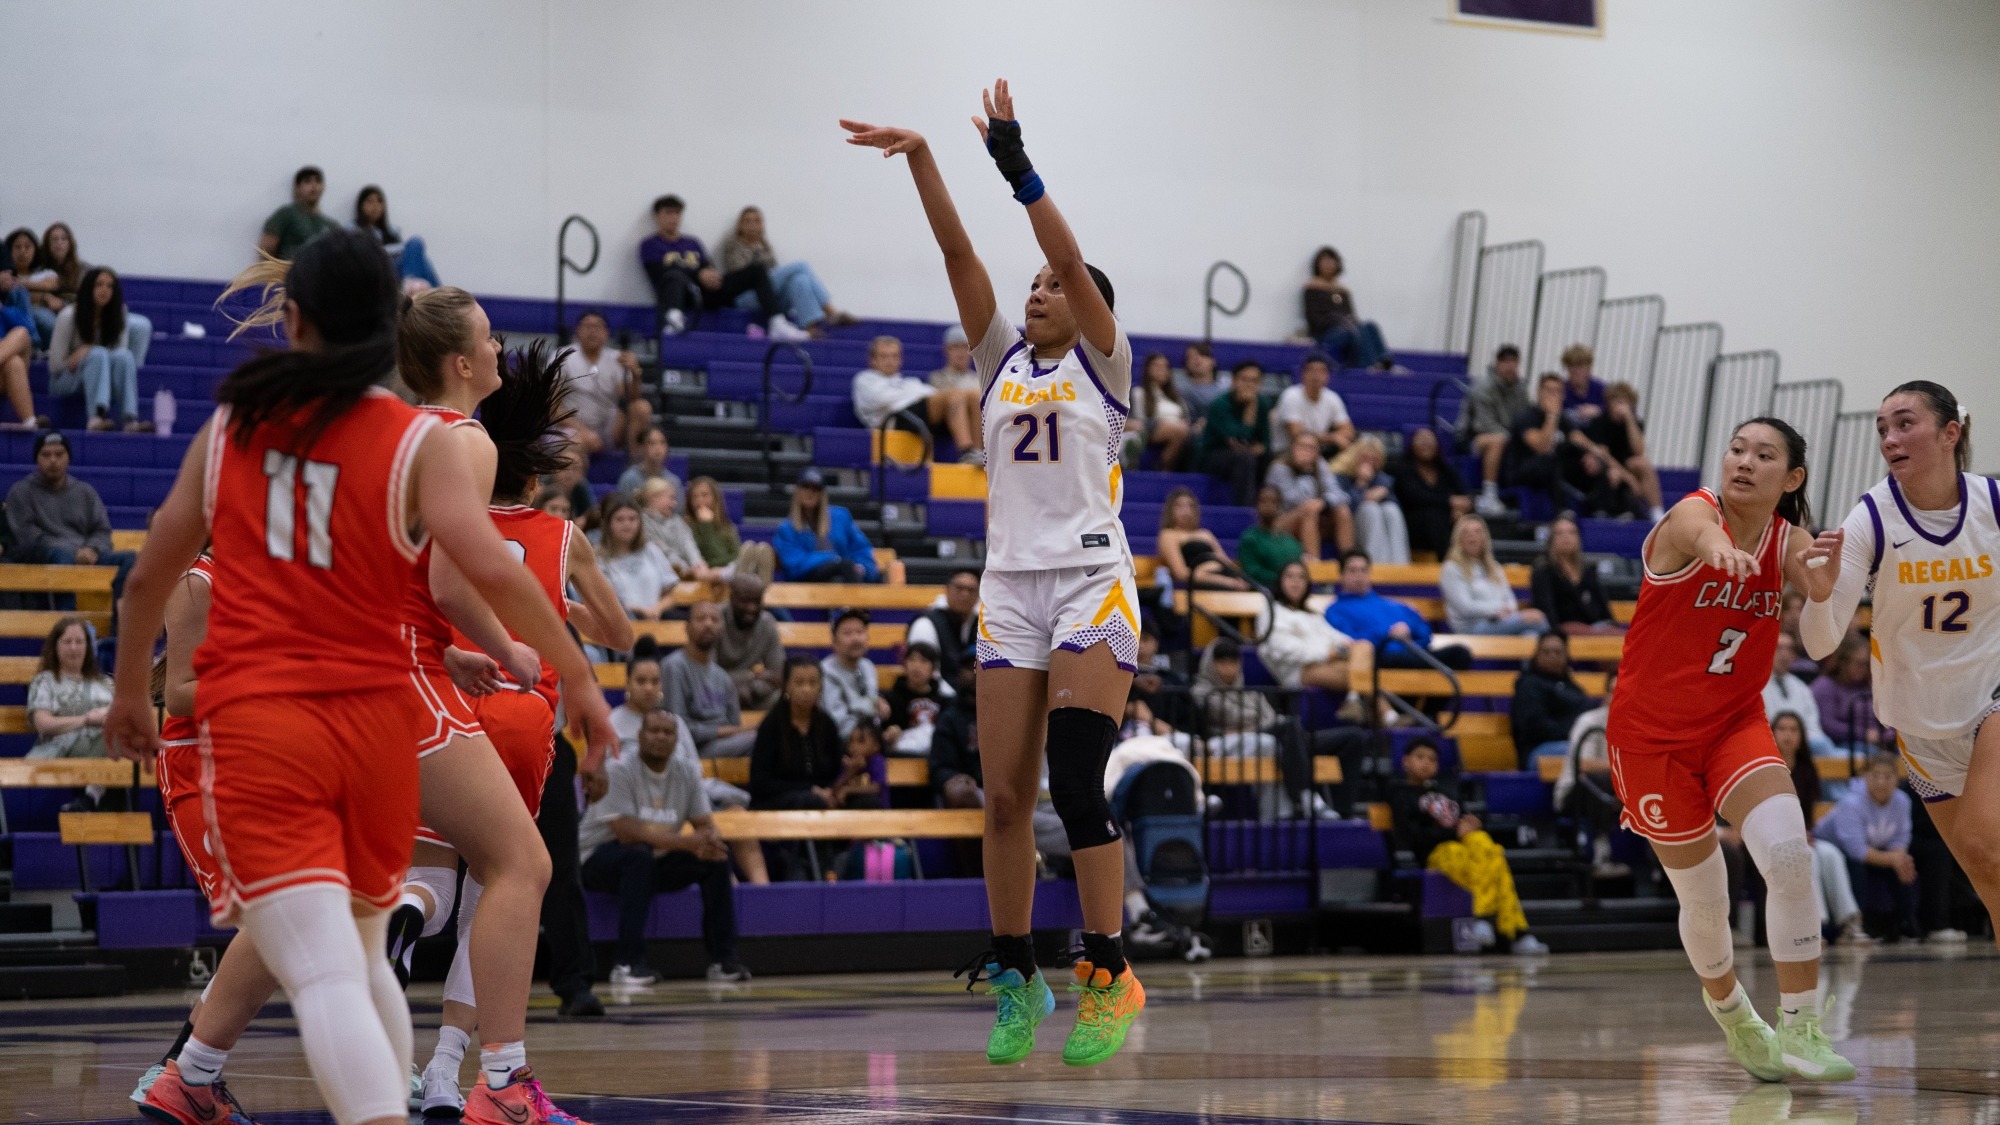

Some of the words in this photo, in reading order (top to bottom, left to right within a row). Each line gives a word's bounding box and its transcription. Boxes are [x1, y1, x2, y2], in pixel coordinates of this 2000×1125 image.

[1010, 410, 1062, 464] 21
[262, 447, 341, 571] 11
[1898, 553, 1994, 585] REGALS
[1920, 589, 1972, 634] 12
[1705, 626, 1749, 675] 2
